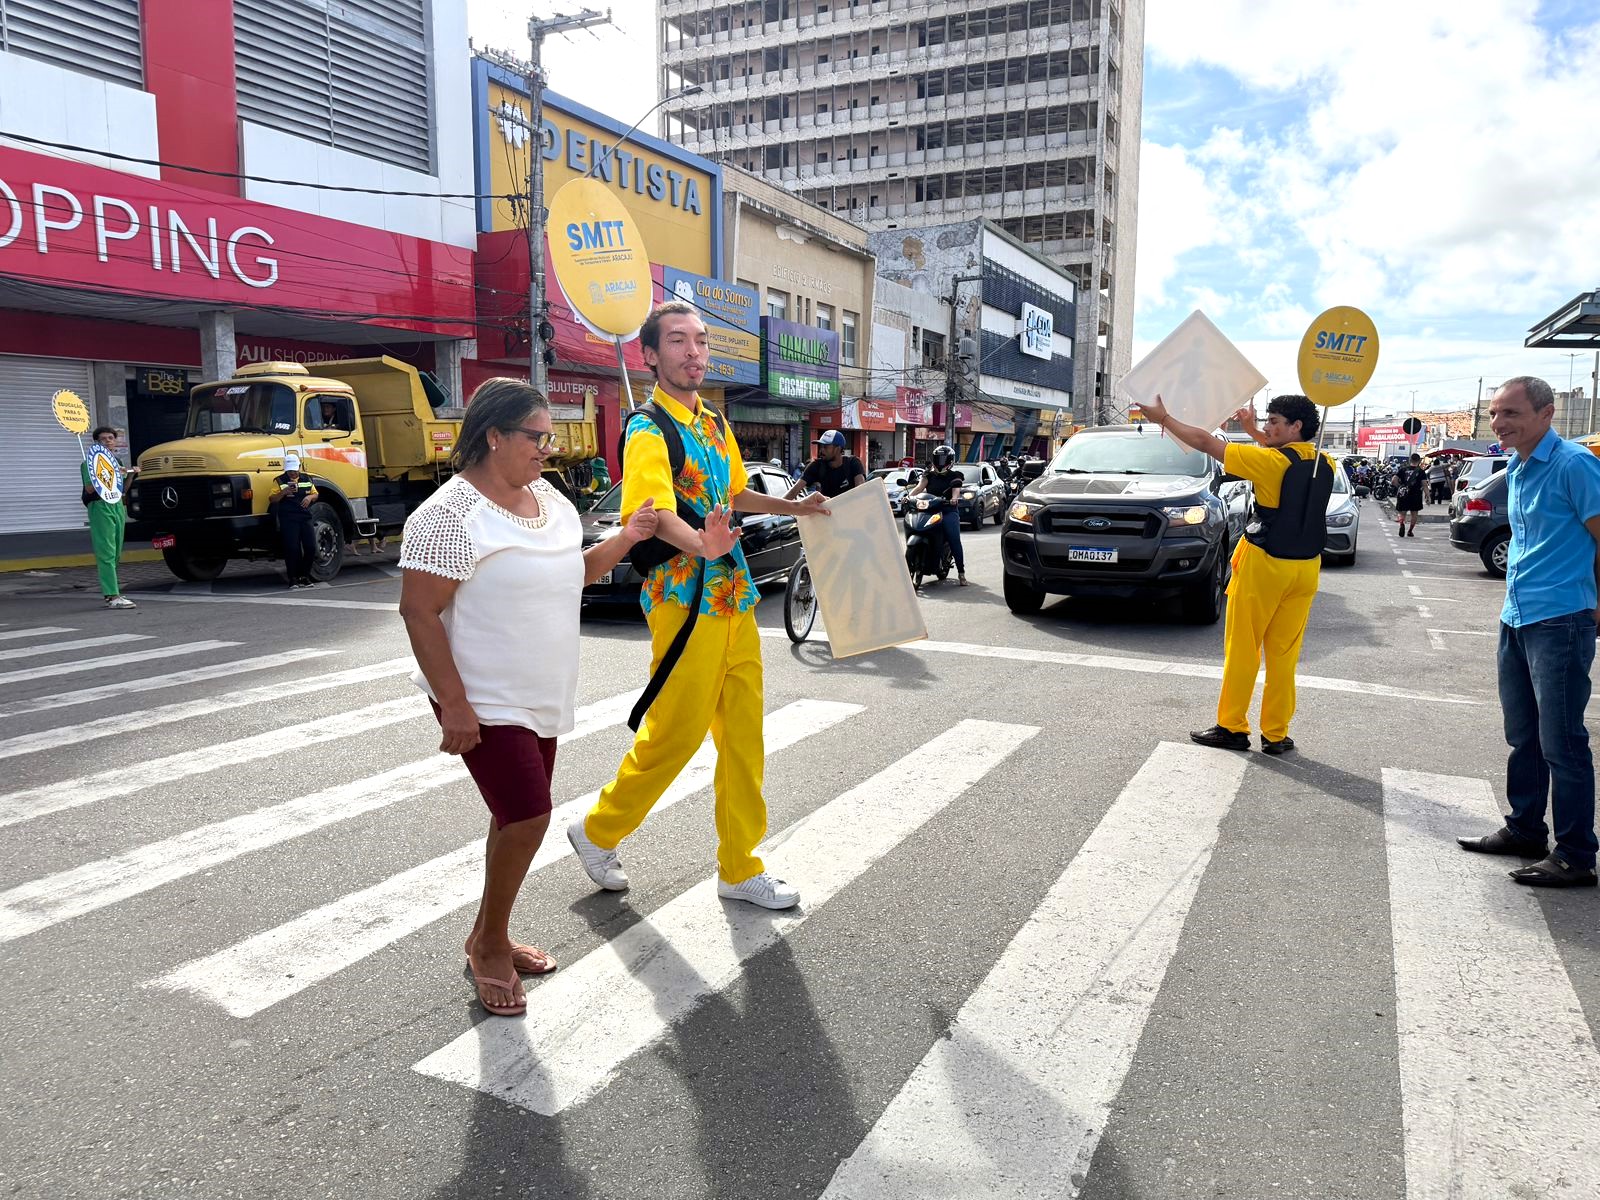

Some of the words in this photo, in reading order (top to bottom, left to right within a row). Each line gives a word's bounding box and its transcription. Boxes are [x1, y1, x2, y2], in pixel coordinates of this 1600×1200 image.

[541, 118, 701, 215] DENTISTA
[566, 220, 625, 251] SMTT
[605, 280, 637, 292] ARACAJU
[696, 279, 711, 297] Cia
[713, 285, 723, 300] do
[1315, 330, 1368, 353] SMTT
[240, 344, 271, 362] AJU
[149, 373, 184, 393] Best
[160, 371, 174, 382] The
[779, 376, 831, 400] COSMÉTICOS
[57, 401, 83, 409] EDUCAÇÃO
[62, 415, 86, 423] TRÂNSITO
[1368, 433, 1406, 441] TRABALHADOR
[1088, 519, 1104, 527] Ford
